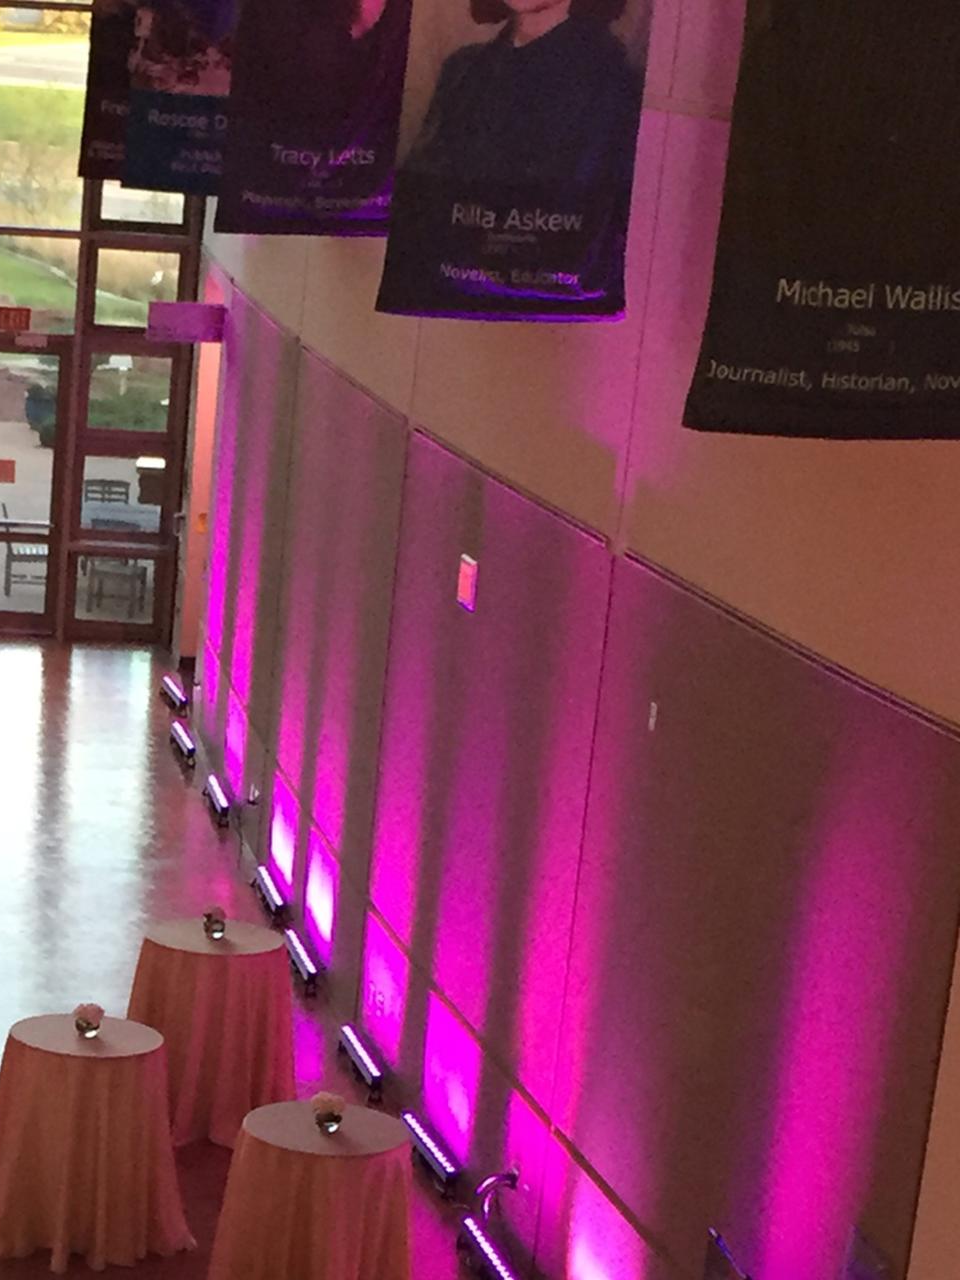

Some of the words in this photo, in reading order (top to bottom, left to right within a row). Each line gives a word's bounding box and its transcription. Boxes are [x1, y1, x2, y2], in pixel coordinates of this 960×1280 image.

[270, 143, 321, 168] Tracy
[327, 147, 376, 166] Letts
[451, 203, 497, 230] Rilla
[503, 208, 584, 232] Askew
[776, 278, 875, 310] Michael
[707, 359, 814, 392] Journalist,
[821, 371, 916, 395] Historian,
